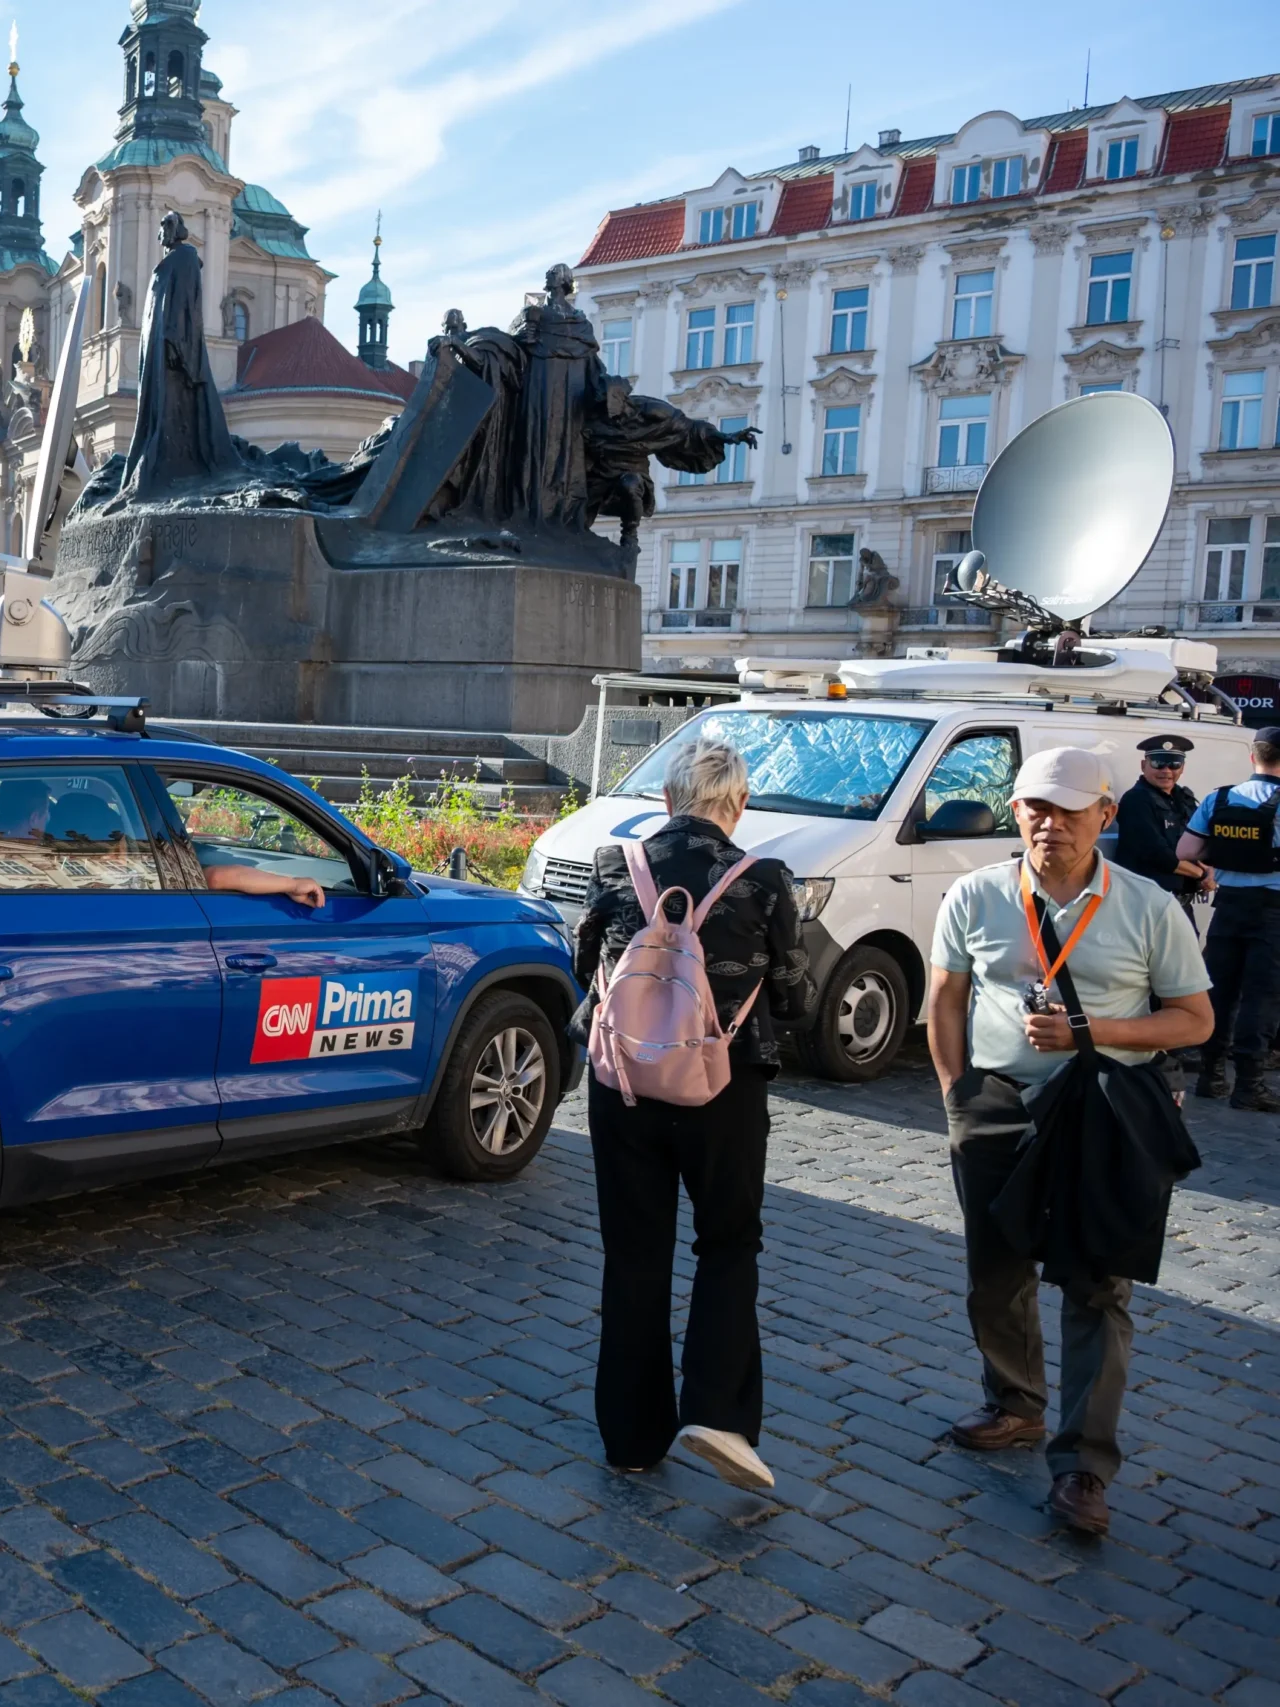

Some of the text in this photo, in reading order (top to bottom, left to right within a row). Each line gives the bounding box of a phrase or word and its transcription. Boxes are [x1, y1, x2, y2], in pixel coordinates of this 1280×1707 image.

[1214, 824, 1260, 839] POLICIE
[322, 979, 413, 1025] Prima
[262, 1003, 312, 1037] CNN
[320, 1028, 404, 1052] NEWS
